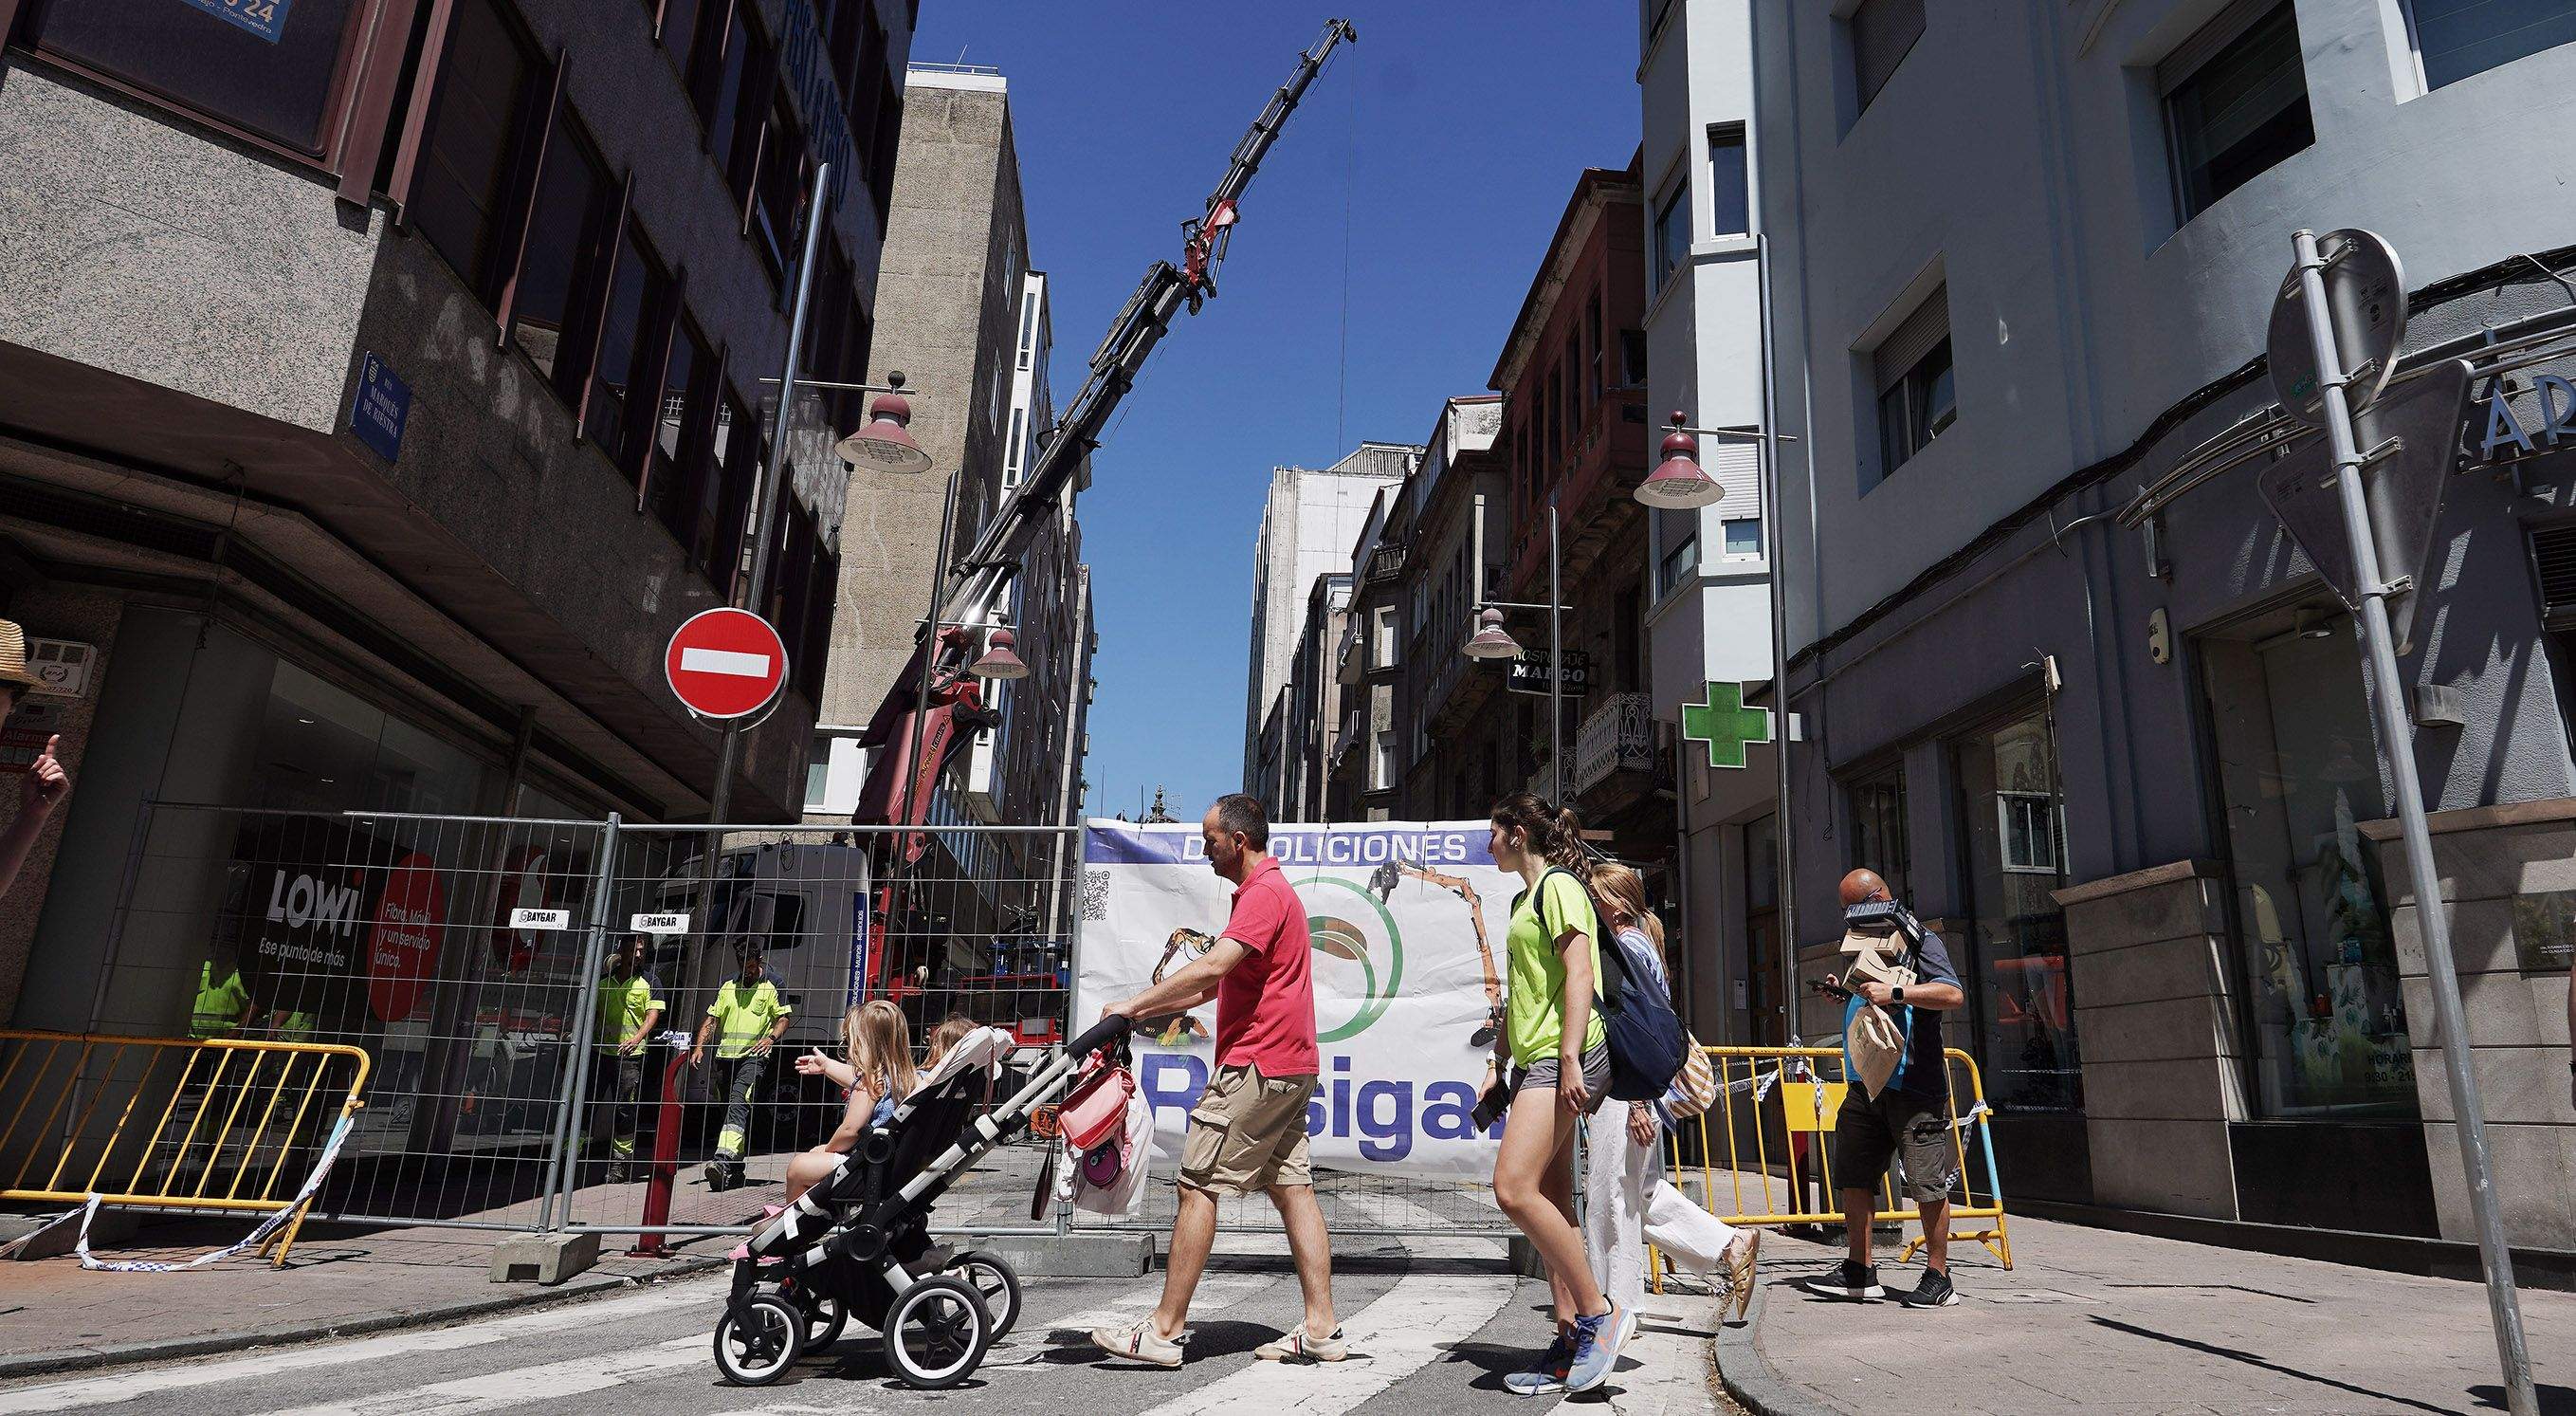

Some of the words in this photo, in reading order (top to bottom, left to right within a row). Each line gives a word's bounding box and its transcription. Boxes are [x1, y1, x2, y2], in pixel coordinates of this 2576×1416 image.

[363, 398, 373, 415] DE
[1182, 834, 1468, 863] DOLICIONES
[258, 937, 278, 956] Ese
[278, 944, 310, 964] punto
